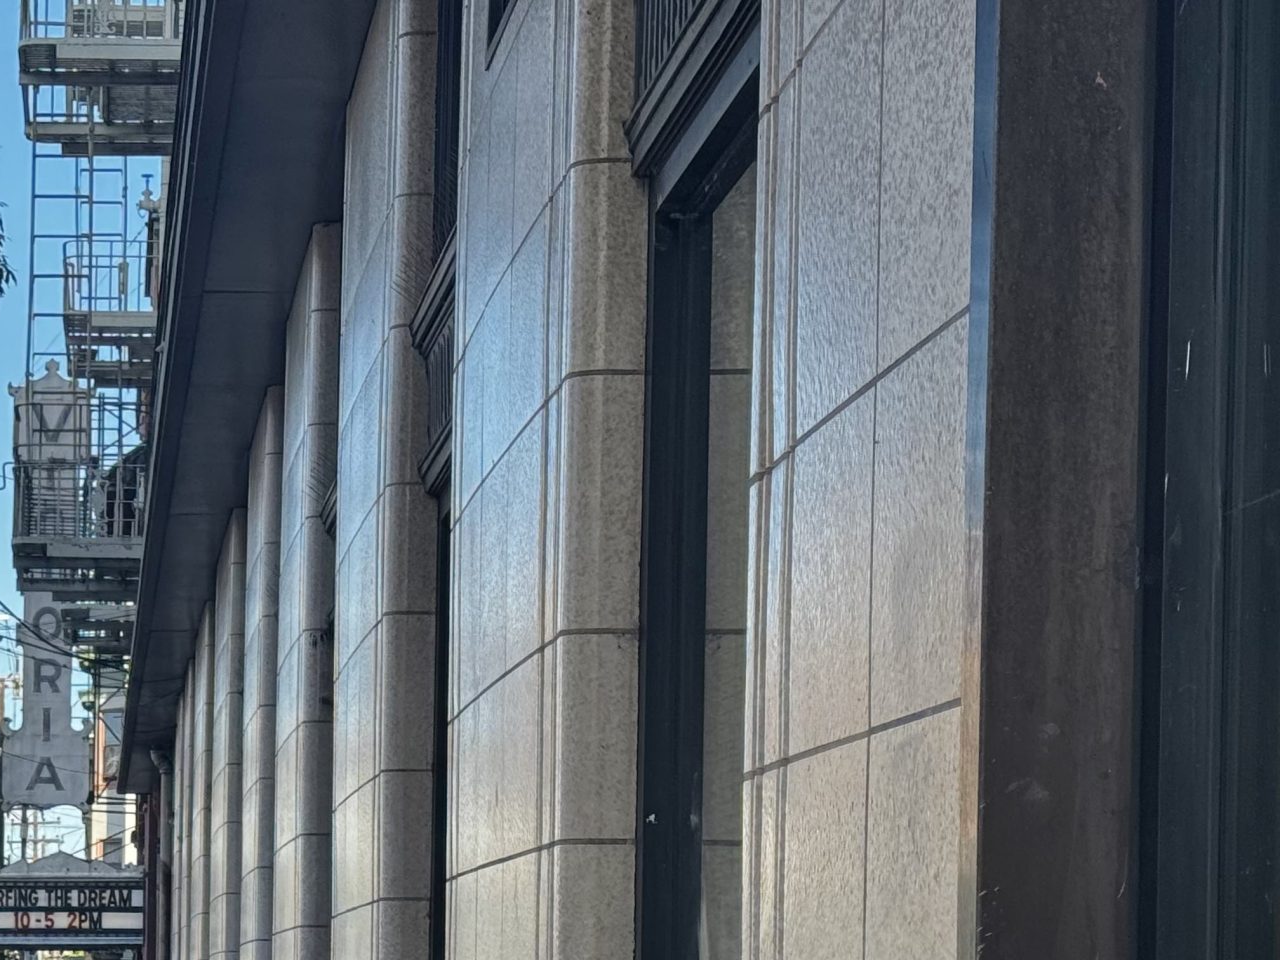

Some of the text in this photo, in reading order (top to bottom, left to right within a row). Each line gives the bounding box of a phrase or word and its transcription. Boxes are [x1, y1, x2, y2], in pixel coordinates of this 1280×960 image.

[47, 888, 72, 907] THE
[77, 888, 132, 907] DREAM
[66, 911, 102, 929] 2PM
